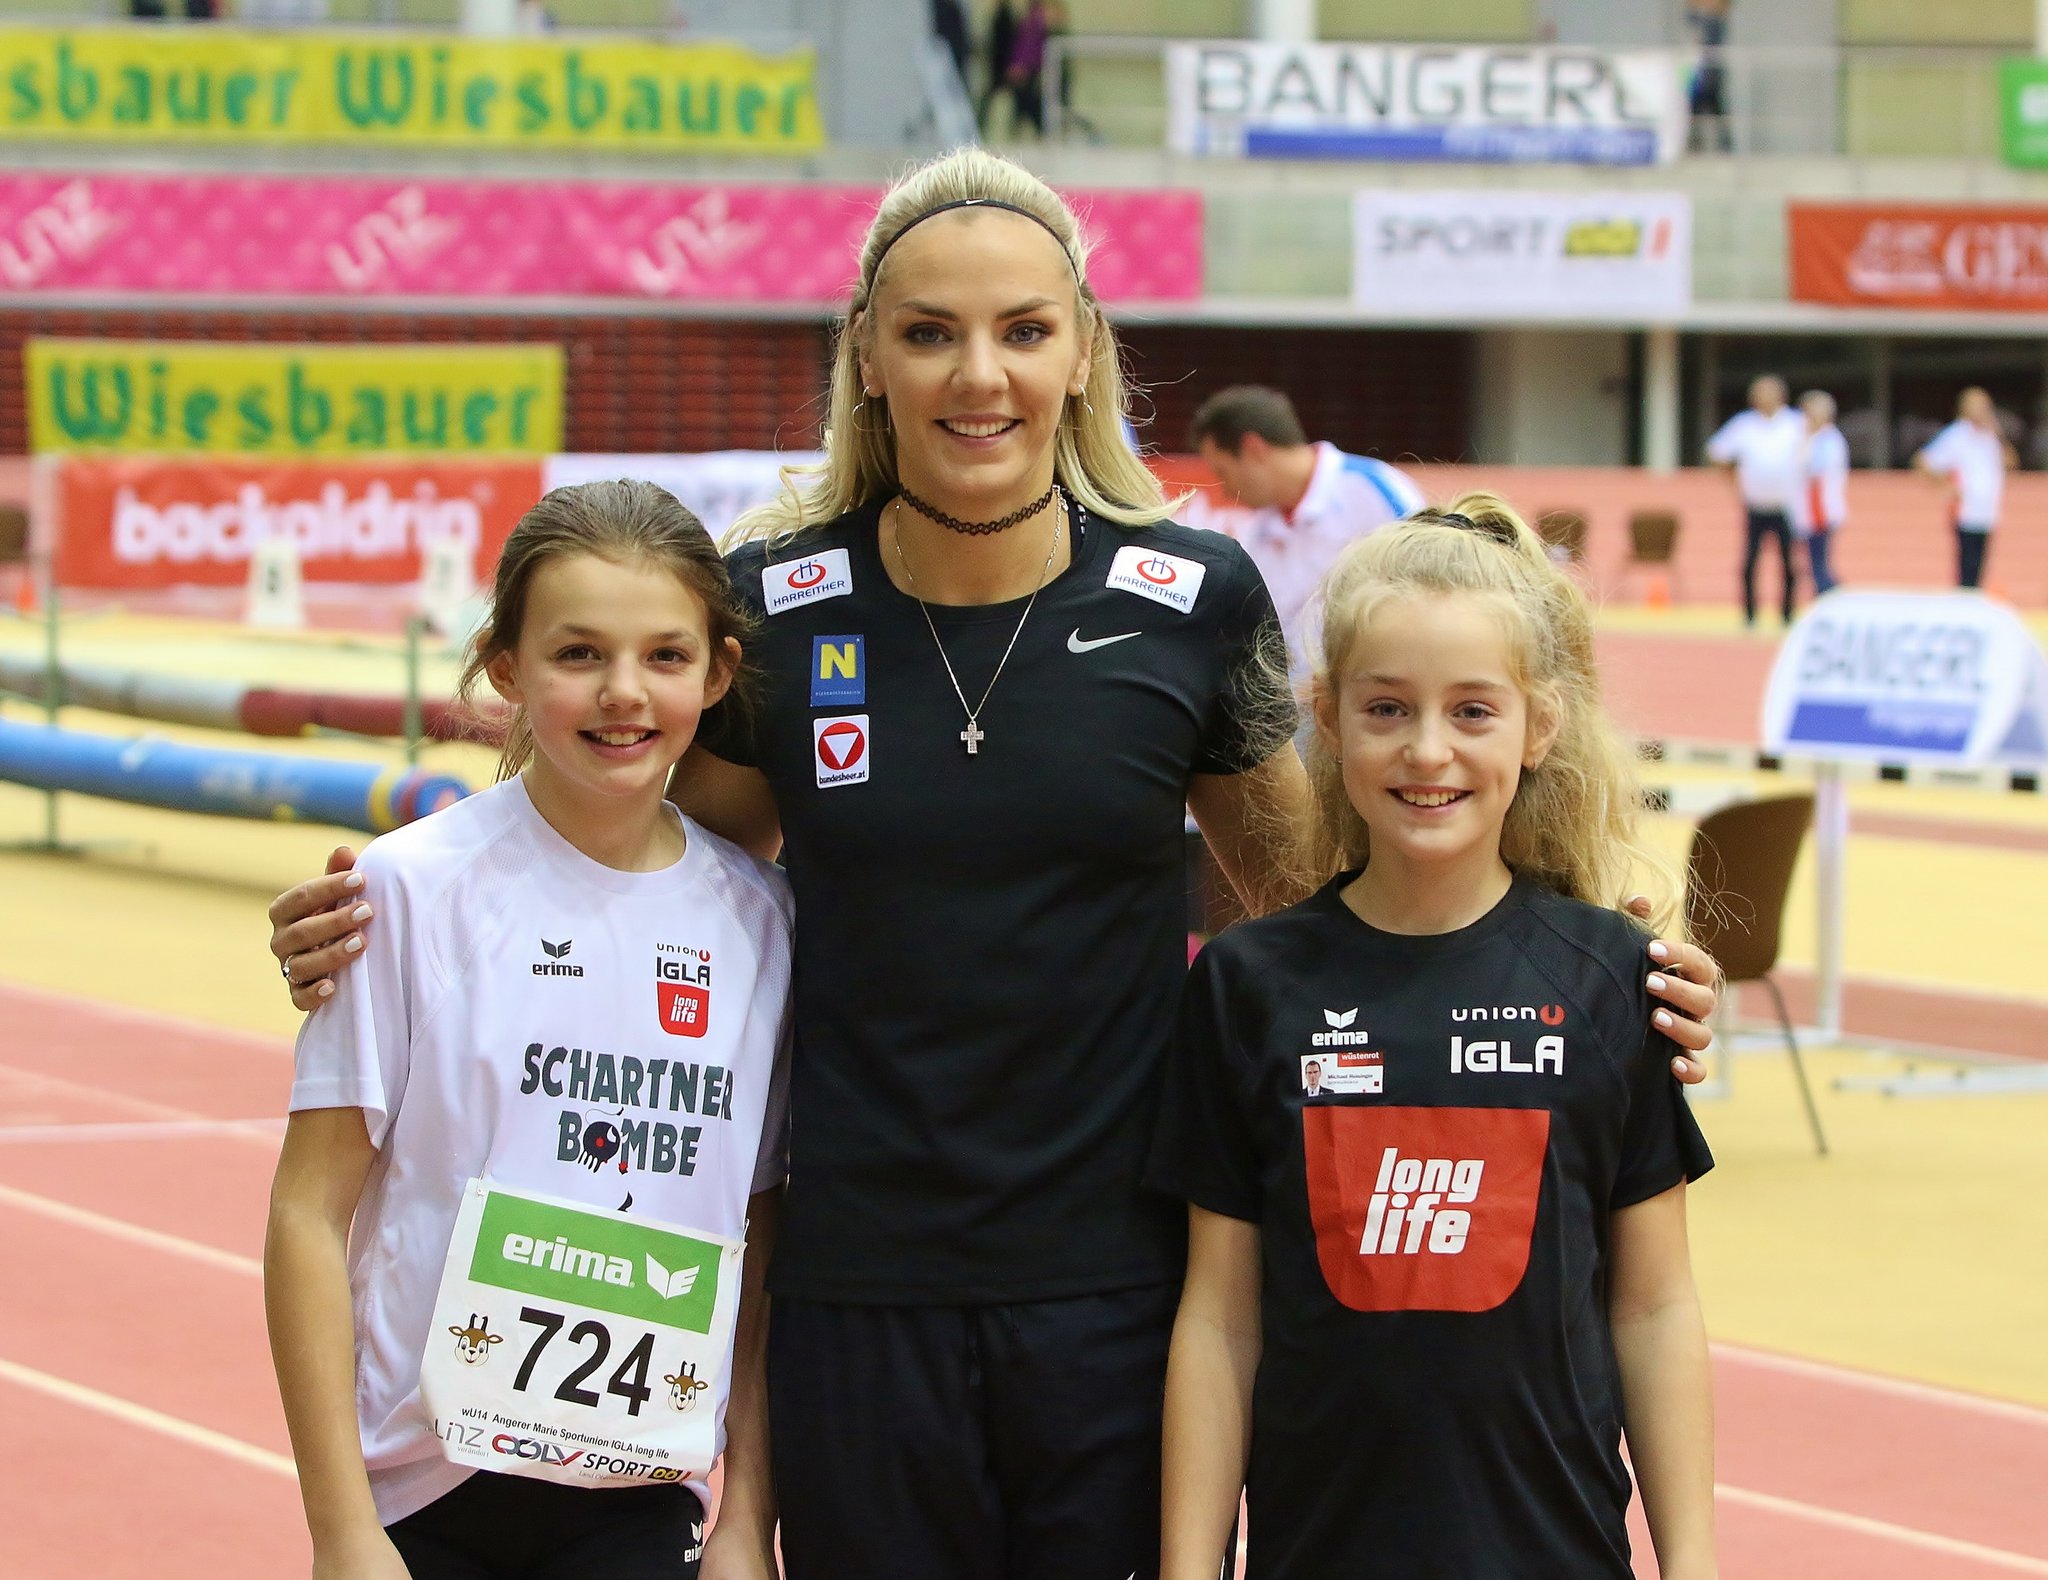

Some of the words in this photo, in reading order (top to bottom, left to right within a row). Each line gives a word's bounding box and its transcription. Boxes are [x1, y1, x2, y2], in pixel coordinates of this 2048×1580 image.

[8, 36, 298, 126] sbauer
[335, 46, 807, 136] Wiesbauer
[49, 359, 541, 447] Wiesbauer
[773, 579, 846, 608] HARREITHER
[1114, 573, 1188, 606] HARREITHER
[820, 643, 857, 679] N
[819, 769, 866, 784] bundesheer.at
[532, 961, 584, 977] erima
[656, 956, 710, 987] IGLA
[670, 1005, 696, 1024] life
[674, 994, 698, 1010] long
[1312, 1029, 1369, 1047] erima
[1341, 1052, 1380, 1061] wüstenrot
[1450, 1035, 1565, 1076] IGLA
[520, 1042, 734, 1121] SCHARTNER
[1374, 1147, 1485, 1203] long
[1359, 1193, 1471, 1255] life
[502, 1231, 634, 1288] erima
[512, 1306, 656, 1417] 724
[461, 1408, 488, 1420] wU14
[492, 1414, 531, 1430] Angerer
[532, 1422, 558, 1436] Marie
[559, 1428, 609, 1447] Sportunion
[611, 1439, 633, 1453] IGLA
[635, 1445, 653, 1457] long
[655, 1449, 670, 1459] life
[583, 1453, 651, 1477] SPORT
[684, 1544, 703, 1562] eri
